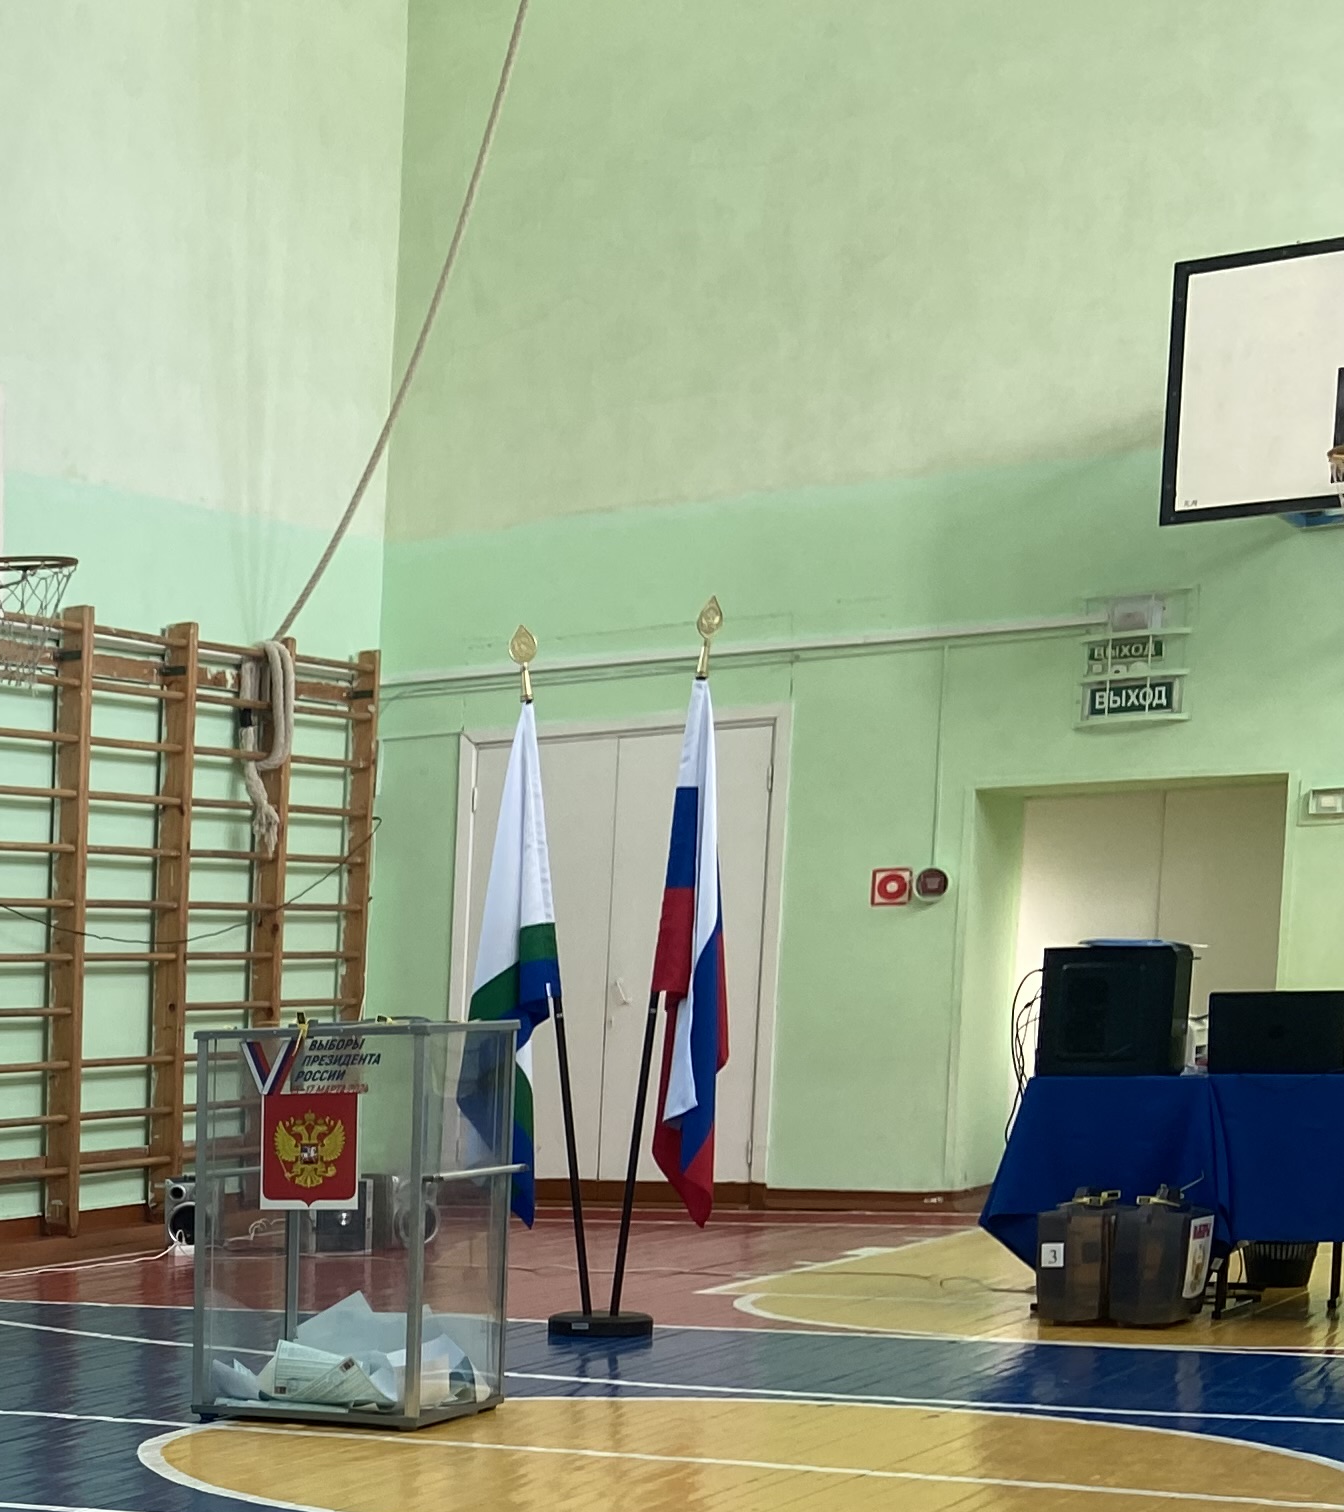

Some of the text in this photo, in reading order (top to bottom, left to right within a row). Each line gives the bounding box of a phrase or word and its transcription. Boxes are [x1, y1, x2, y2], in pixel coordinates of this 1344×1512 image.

[1095, 686, 1167, 709] ВЫХОД
[309, 1038, 365, 1051] ВЫБОРЫ
[302, 1053, 381, 1067] ПРЕЗИДЕНТА
[295, 1070, 346, 1082] РОССИИ
[1048, 1249, 1058, 1265] 3
